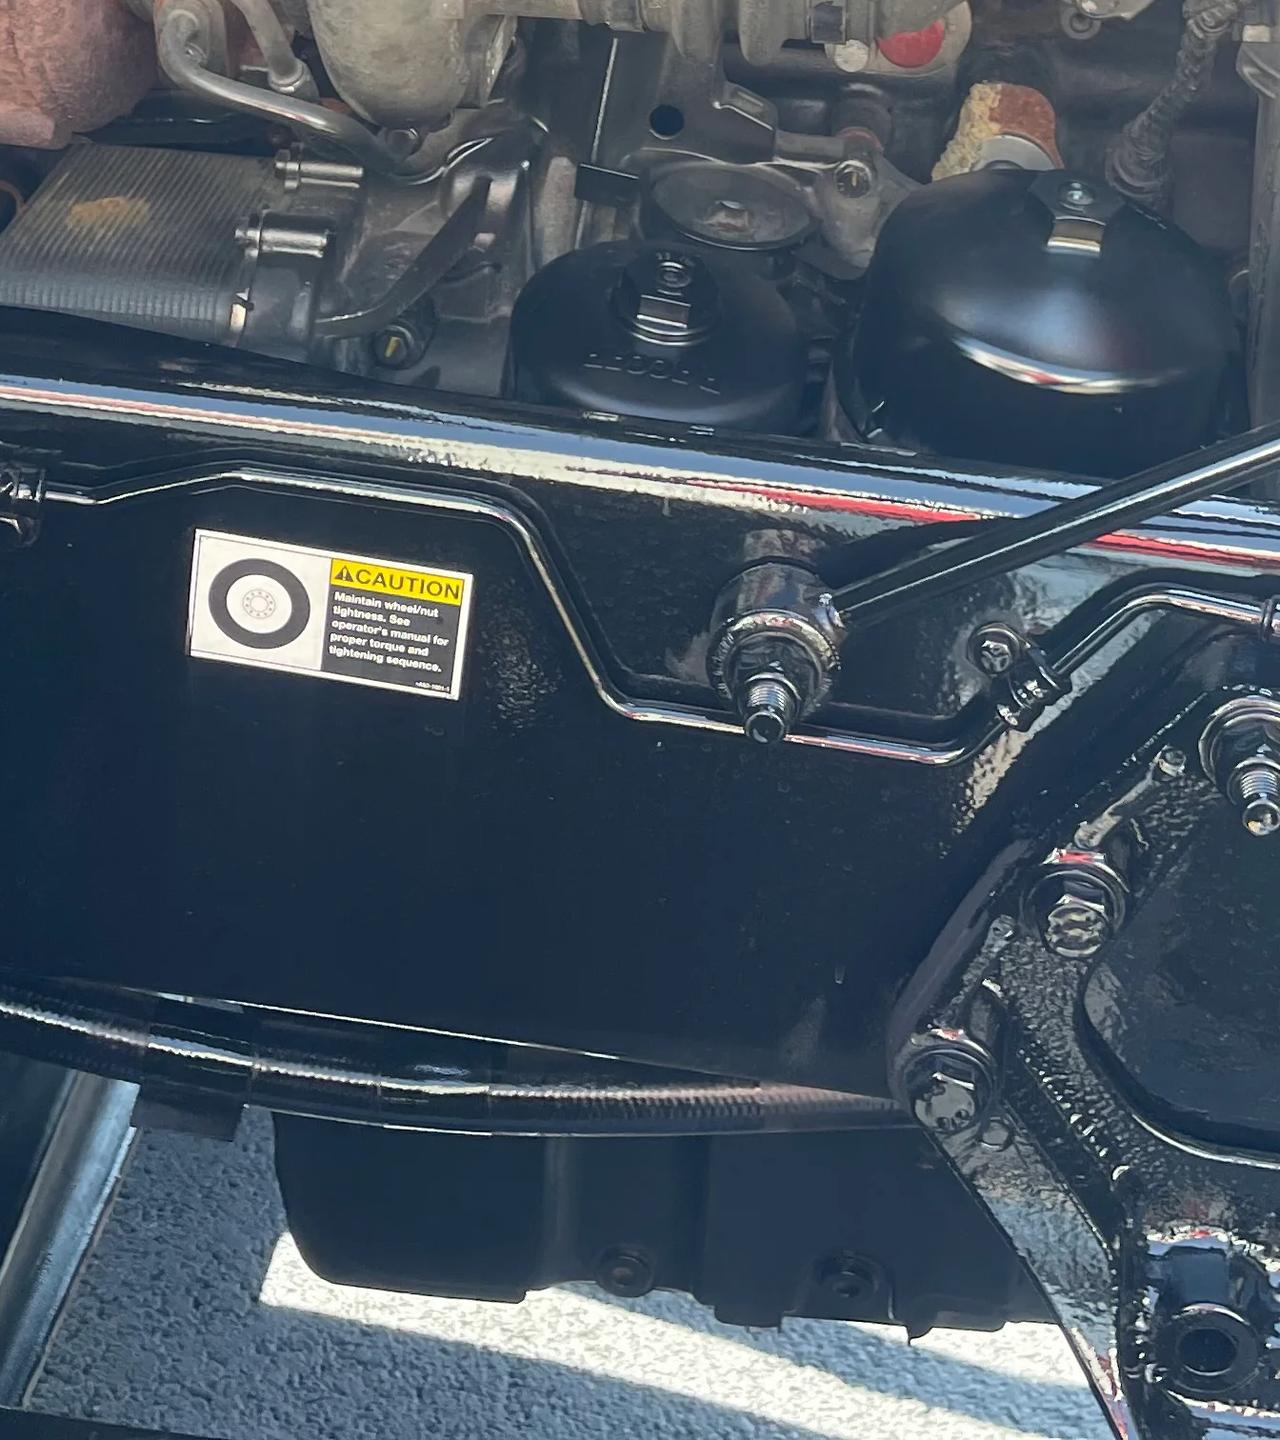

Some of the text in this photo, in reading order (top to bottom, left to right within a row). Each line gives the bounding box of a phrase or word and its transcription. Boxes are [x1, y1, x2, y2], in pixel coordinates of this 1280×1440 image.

[355, 569, 458, 598] CAUTION
[332, 605, 410, 626] tightness. See
[334, 591, 438, 617] Maintain wheel/nut
[330, 633, 429, 656] proper torque and
[331, 618, 448, 646] operator's manual for
[328, 644, 442, 673] tightening sequence.
